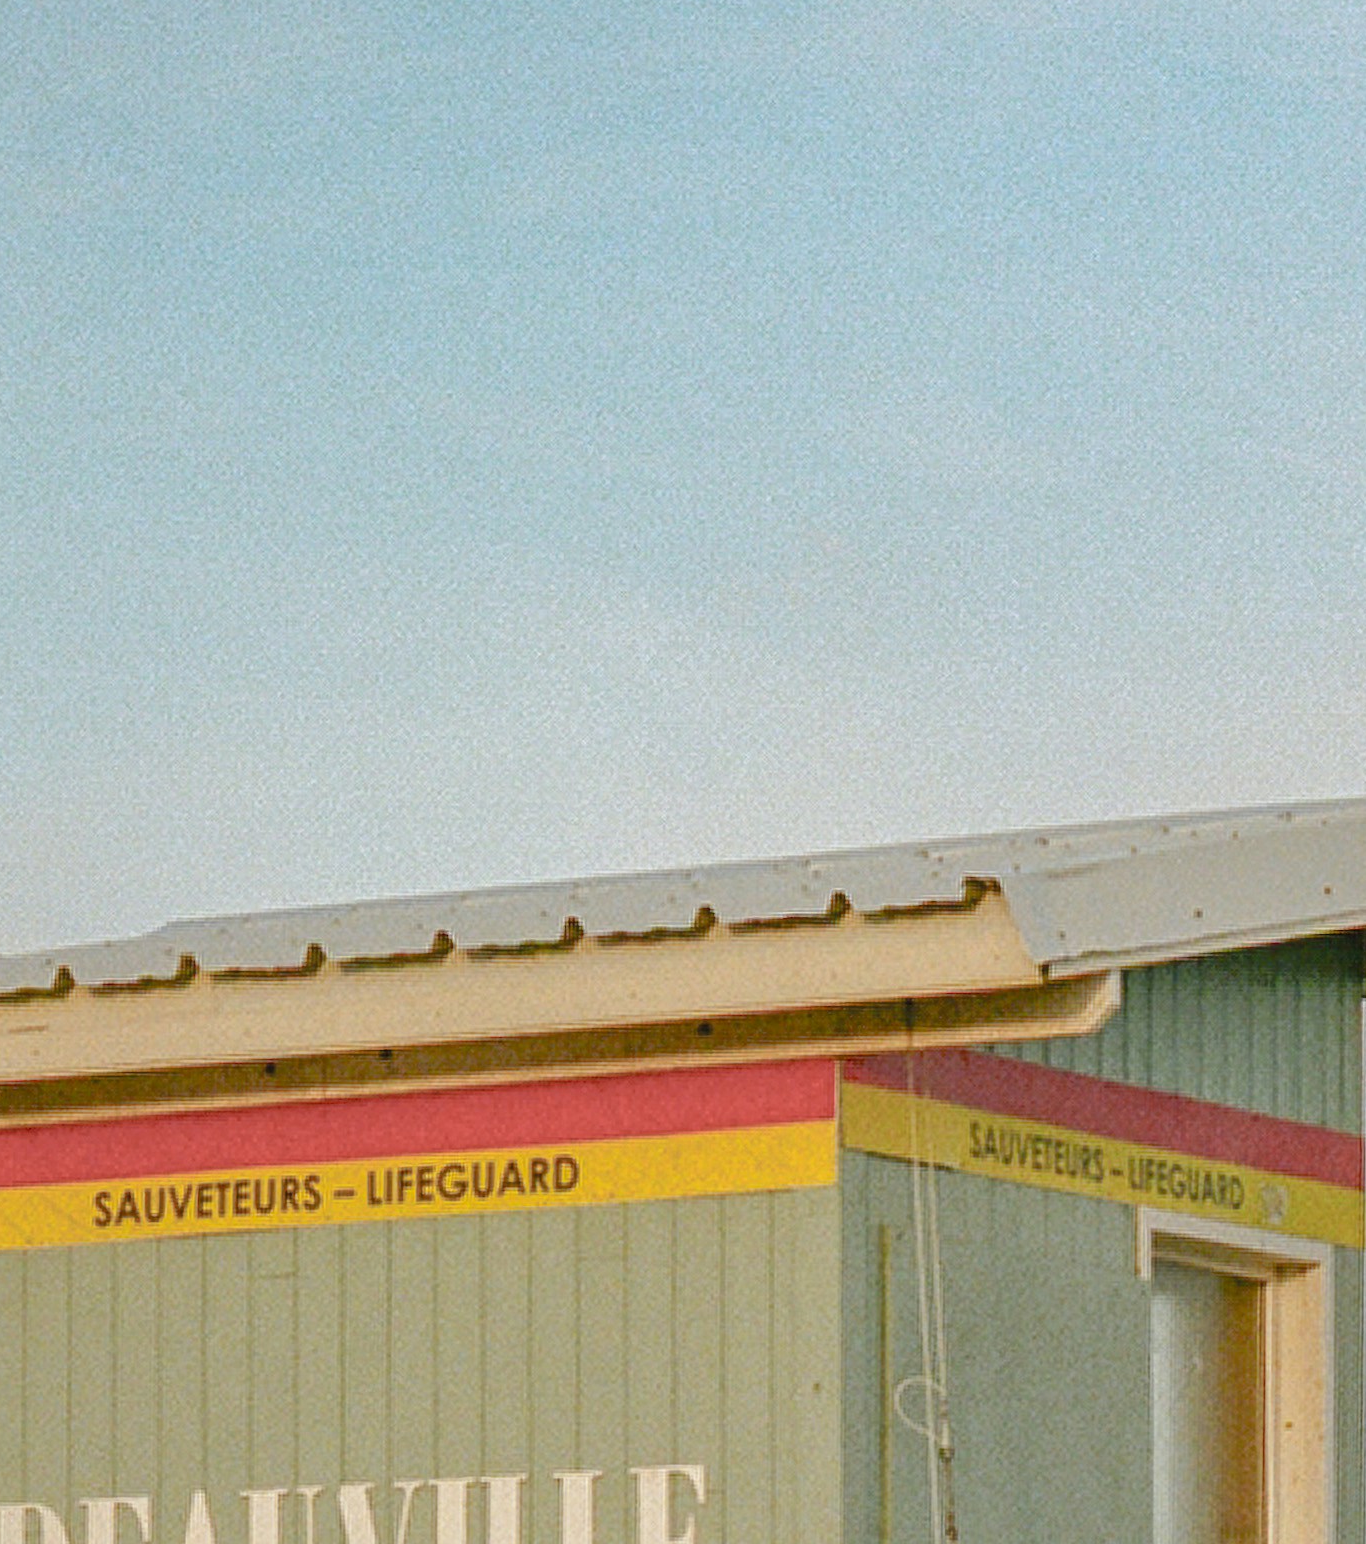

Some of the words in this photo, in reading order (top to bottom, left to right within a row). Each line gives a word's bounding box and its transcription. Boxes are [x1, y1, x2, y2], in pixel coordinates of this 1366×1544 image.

[92, 1175, 322, 1228] SAUVETEURS
[367, 1155, 580, 1206] LIFEGUARD
[969, 1121, 1103, 1182] SAUVETEURS
[1128, 1158, 1244, 1209] LIFEGUARD
